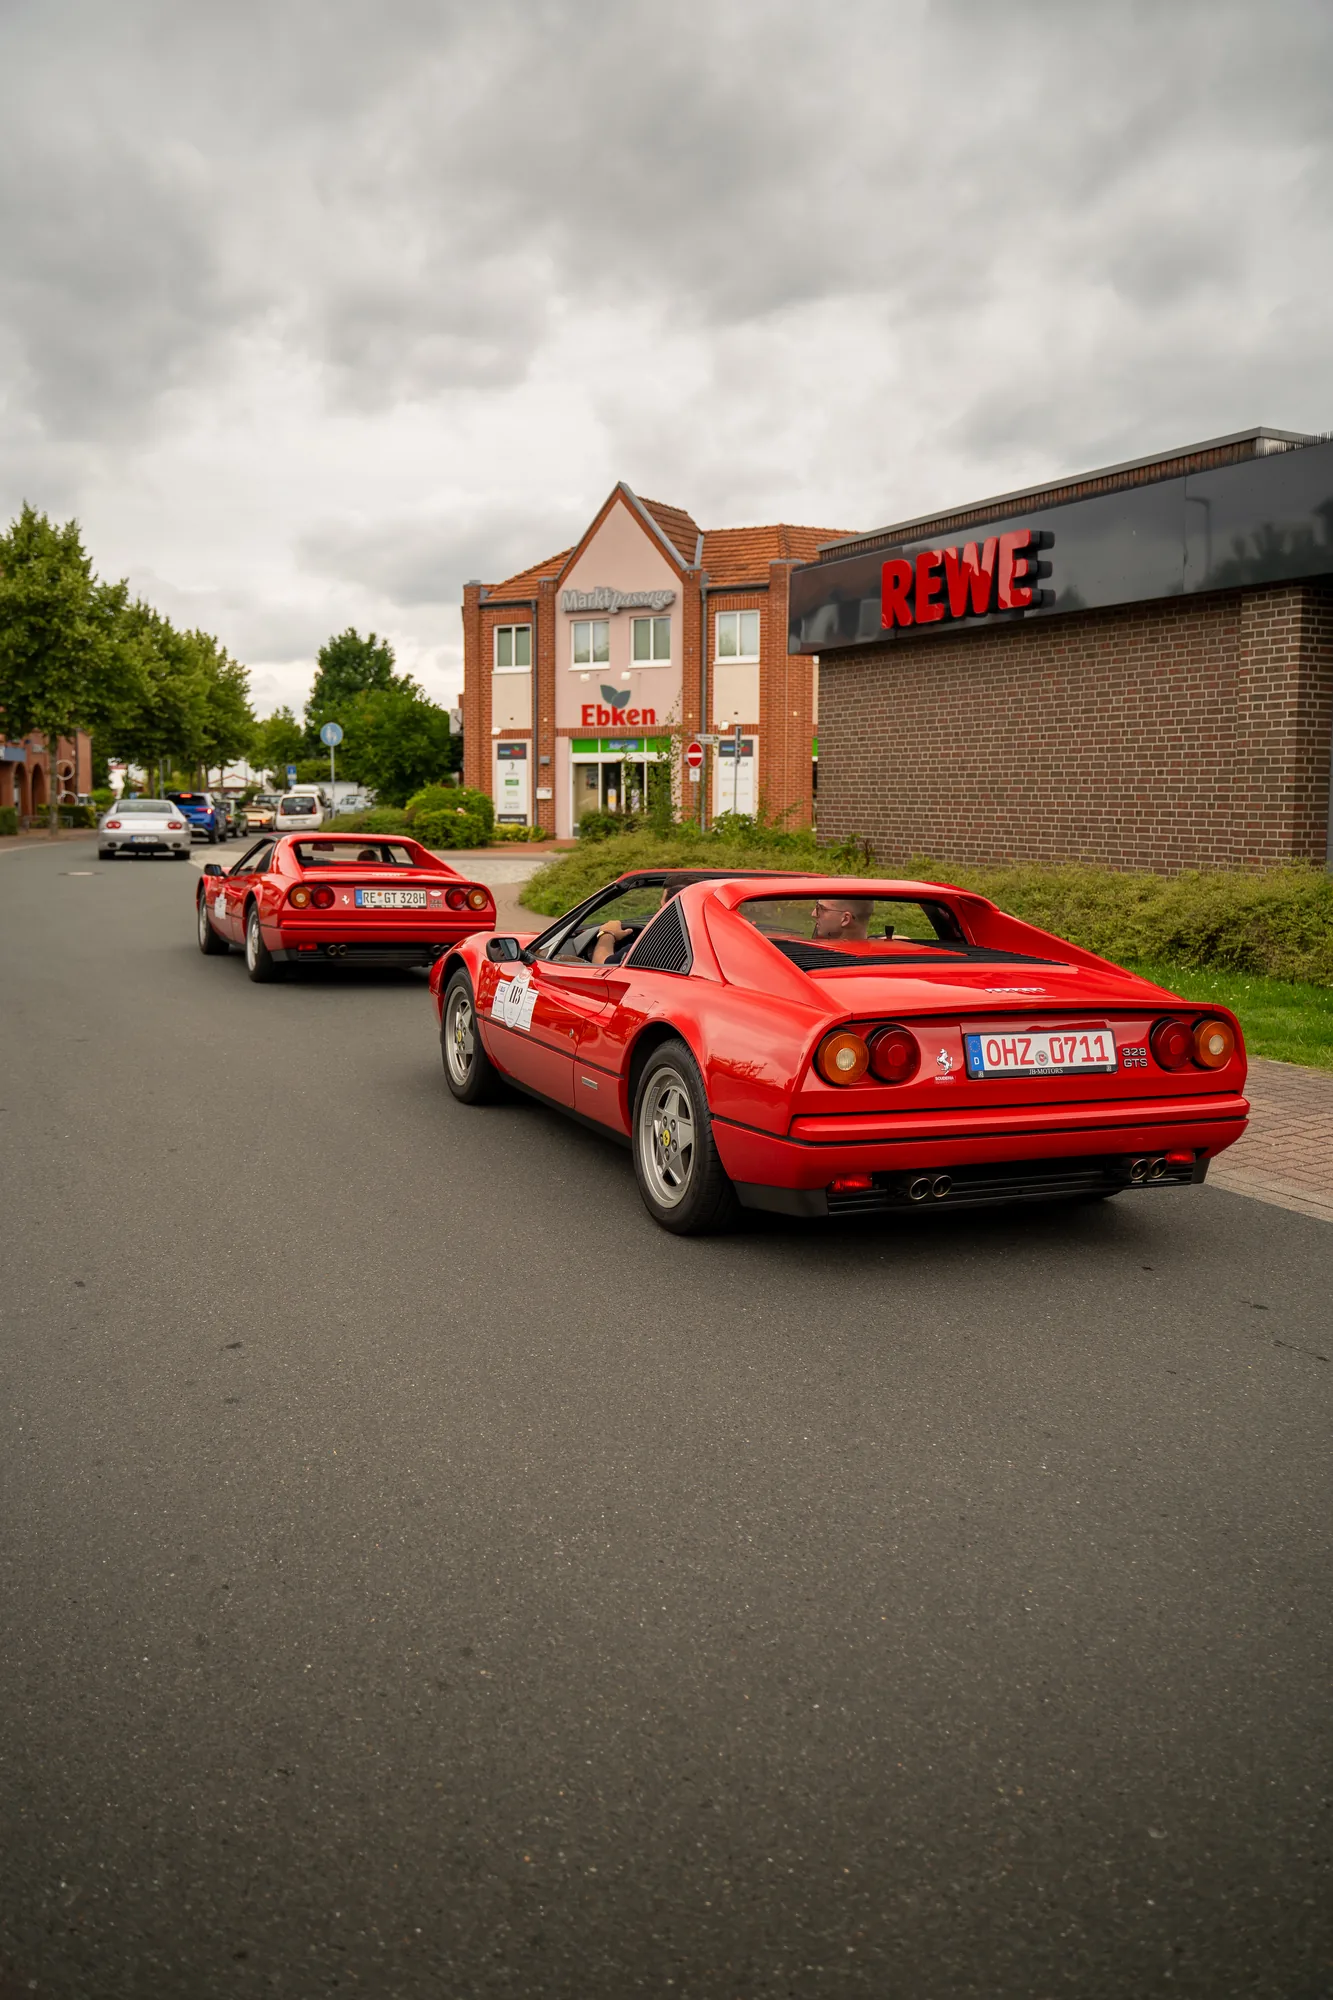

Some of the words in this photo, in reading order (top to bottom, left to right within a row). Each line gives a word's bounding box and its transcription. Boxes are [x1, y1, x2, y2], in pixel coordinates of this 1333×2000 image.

[881, 529, 1032, 629] REWE
[581, 704, 656, 727] Ebken
[363, 892, 376, 903] RE
[384, 892, 397, 904] GT
[400, 892, 425, 904] 328H
[509, 985, 523, 1005] 113
[986, 1038, 1035, 1067] OHZ
[1049, 1035, 1109, 1064] 0711
[1122, 1047, 1147, 1057] 328
[973, 1056, 980, 1065] D
[1123, 1058, 1148, 1067] GTS
